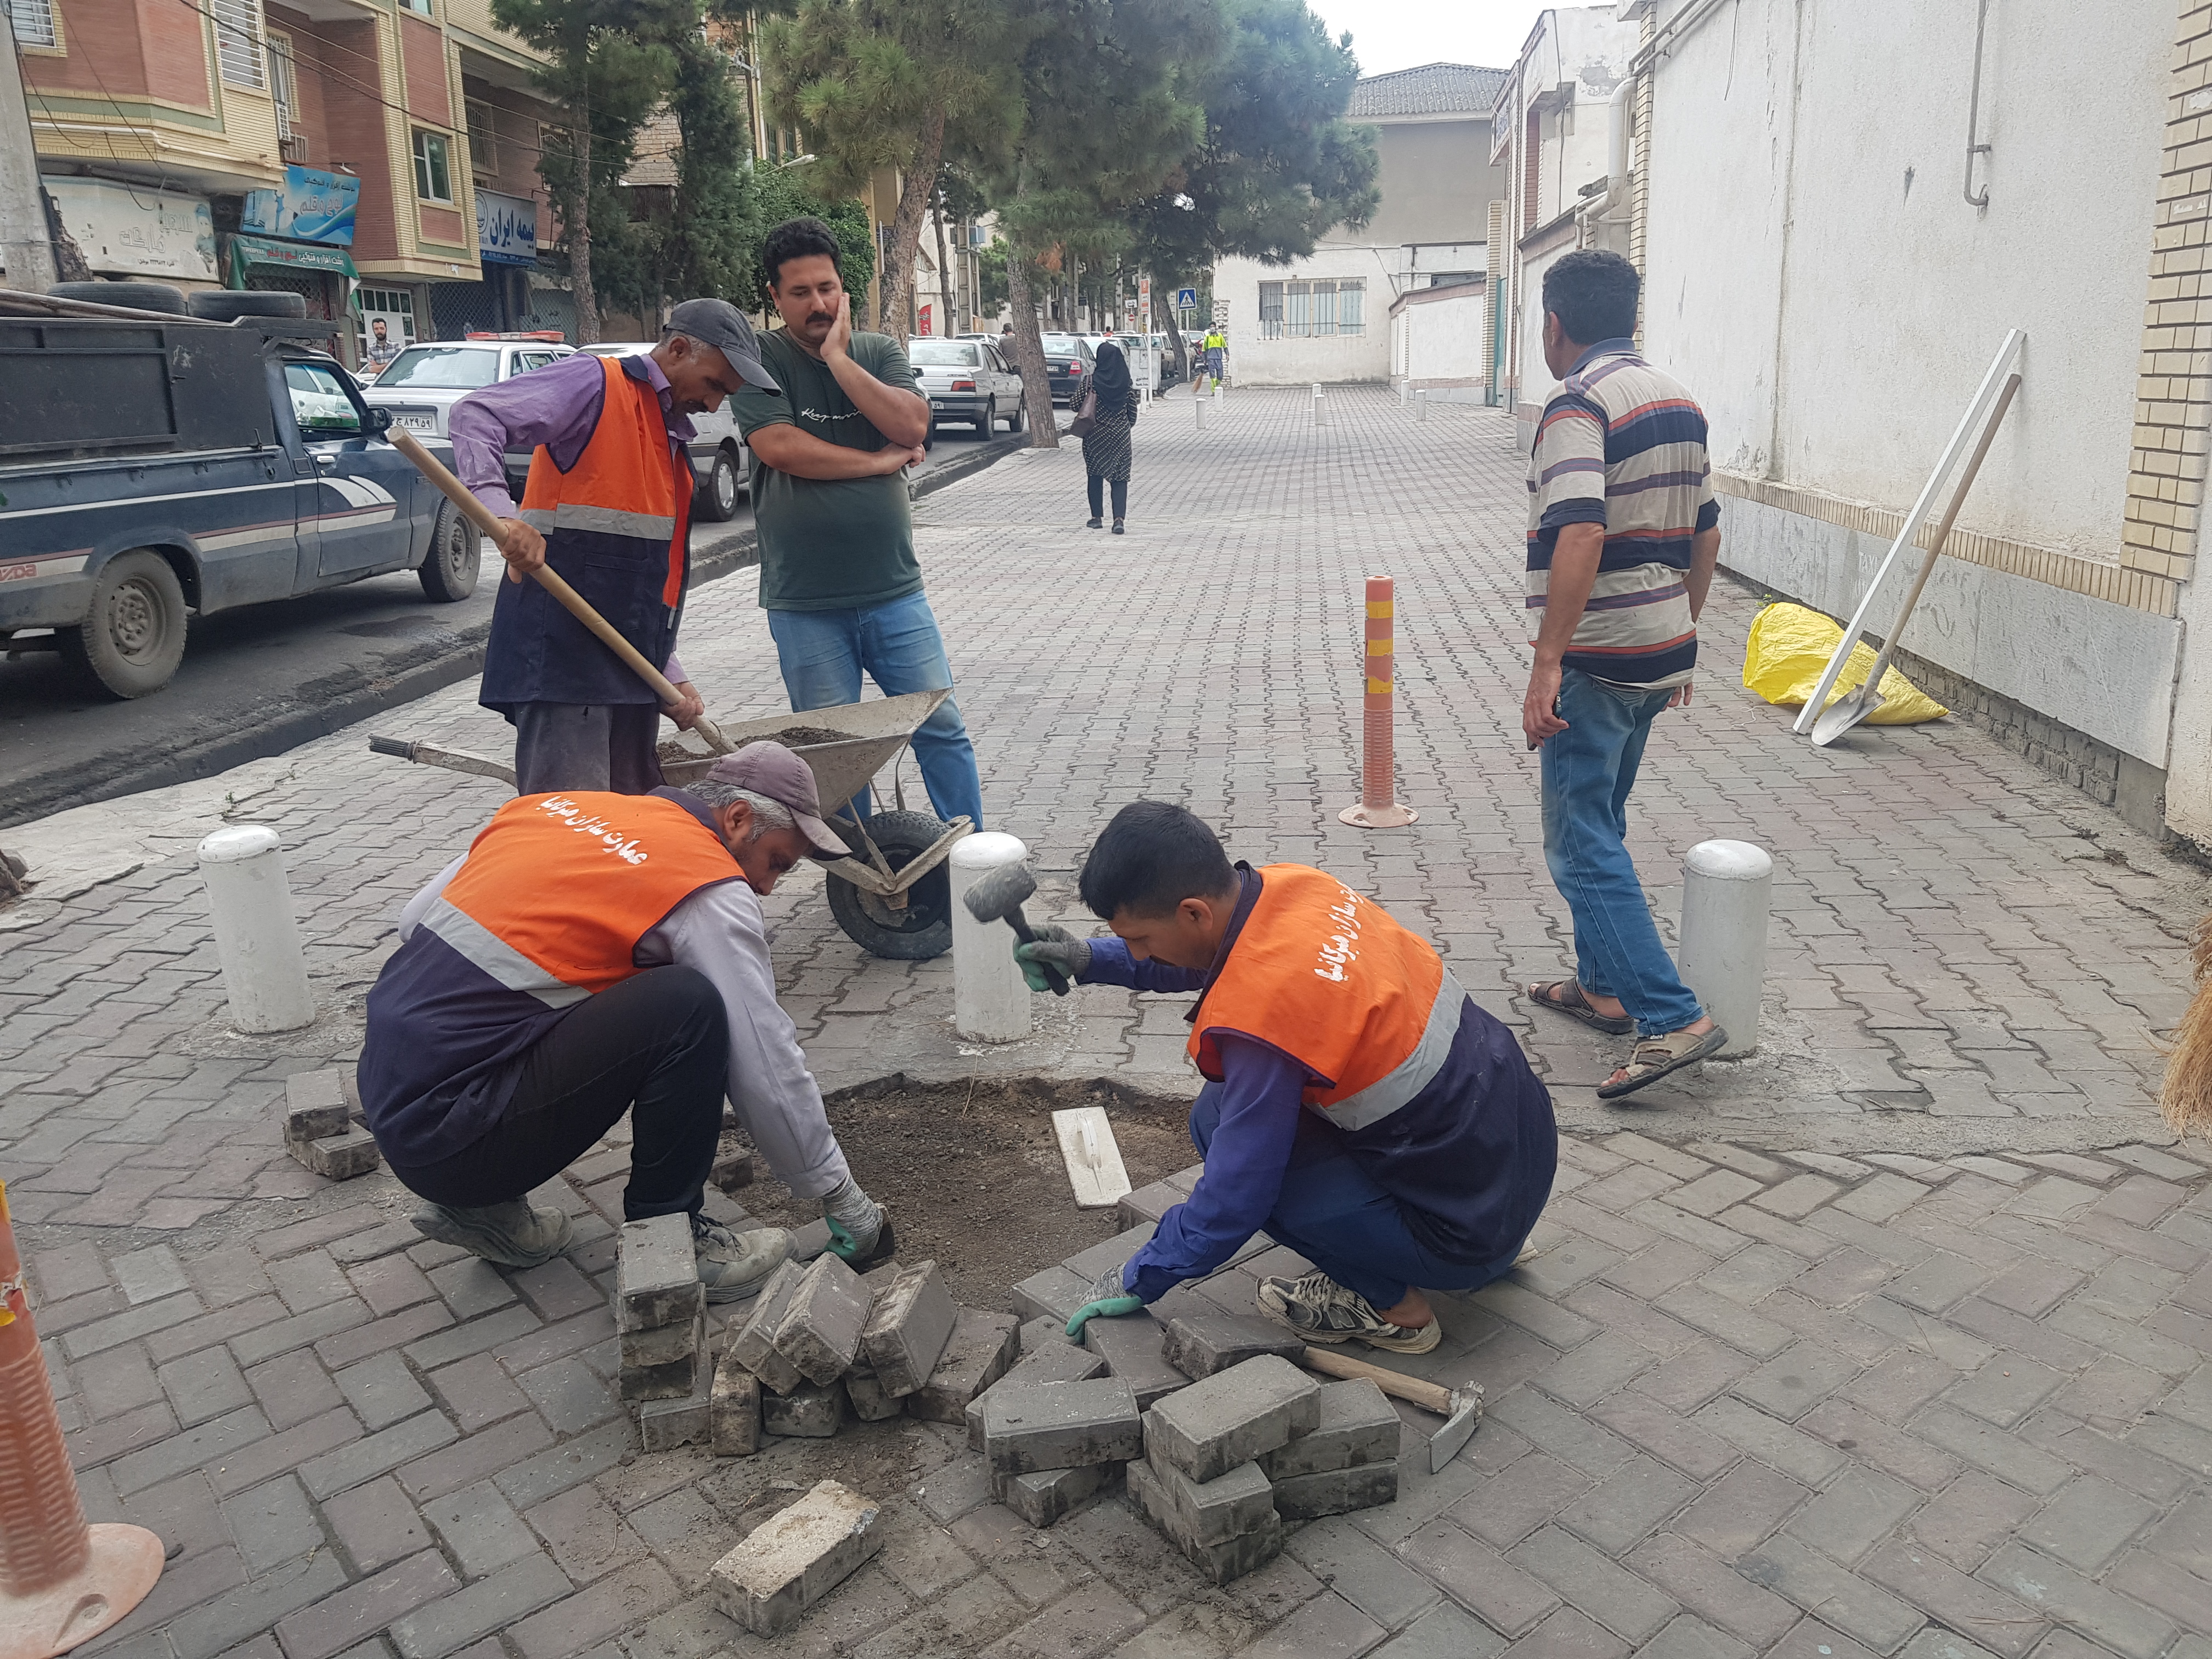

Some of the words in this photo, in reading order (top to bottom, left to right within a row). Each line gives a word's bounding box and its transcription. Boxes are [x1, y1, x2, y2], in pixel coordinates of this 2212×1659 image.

[300, 195, 318, 215] قلم
[319, 199, 325, 216] و
[119, 224, 165, 253] مارکت
[490, 206, 514, 247] ایران
[516, 218, 534, 250] بیمه
[801, 408, 832, 423] Keep
[565, 815, 612, 836] سازان
[602, 832, 647, 865] عمارت
[1328, 901, 1361, 940] سازان
